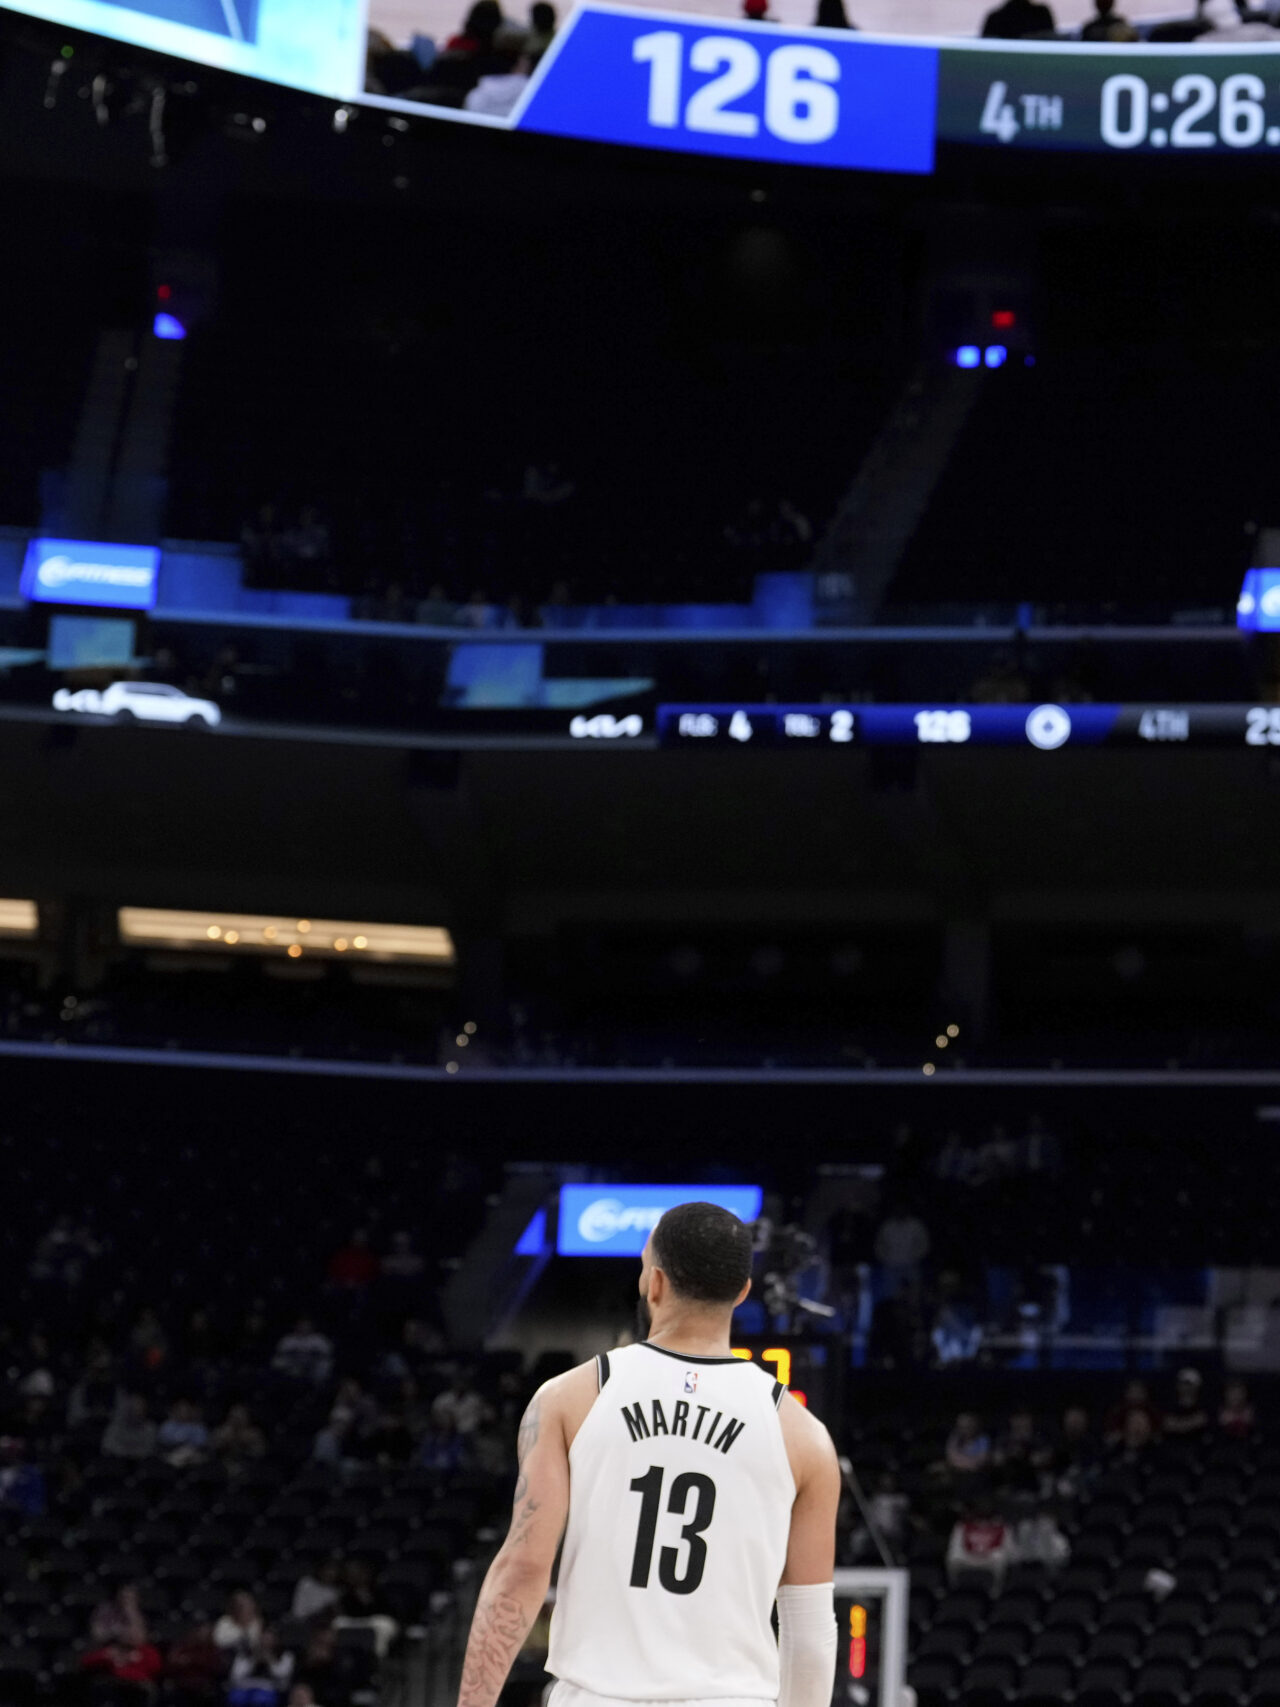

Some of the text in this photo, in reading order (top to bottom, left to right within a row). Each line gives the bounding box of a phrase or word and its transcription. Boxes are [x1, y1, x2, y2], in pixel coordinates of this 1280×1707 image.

[632, 30, 842, 145] 126
[980, 81, 1064, 142] 4TH
[830, 710, 854, 742] 2
[620, 1399, 746, 1455] MARTIN
[629, 1465, 717, 1595] 13
